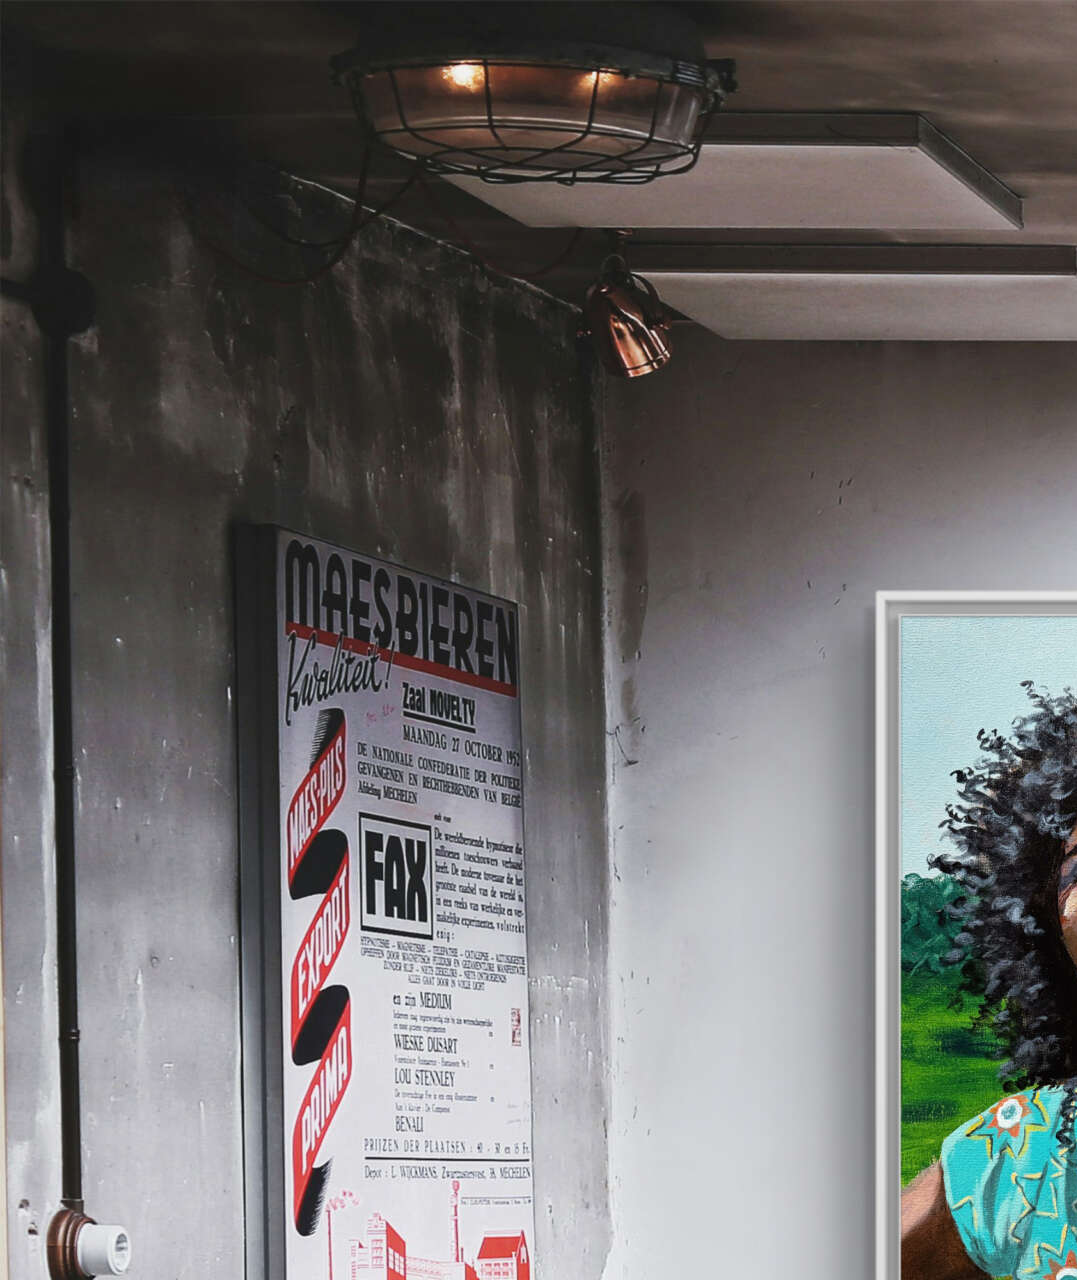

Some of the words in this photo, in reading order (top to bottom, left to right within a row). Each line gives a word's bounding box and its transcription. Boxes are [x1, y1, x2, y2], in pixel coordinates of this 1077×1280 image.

[403, 682, 426, 714] Zaal
[430, 689, 476, 725] NOVELTY
[357, 742, 368, 756] DE
[372, 746, 413, 767] NATIONALE
[418, 757, 470, 780] CONFEDERATIE
[474, 770, 487, 784] DER
[403, 725, 447, 750] MAANDAG
[452, 737, 460, 752] 27
[465, 740, 502, 763] OCTOBER
[357, 762, 404, 783] GEVANGENEN
[409, 774, 418, 786] EN
[484, 789, 497, 803] VAN
[365, 830, 428, 922] FAX
[298, 864, 347, 1019] EXPORT
[420, 992, 452, 1010] MEDIUM
[394, 1034, 424, 1051] WIESKE
[428, 1038, 458, 1054] DUSART
[394, 1068, 411, 1085] LOU
[302, 1026, 348, 1175] PRIMA
[364, 1138, 399, 1153] PRIJZEN
[404, 1139, 420, 1153] DER
[424, 1140, 466, 1154] PLAATSEN
